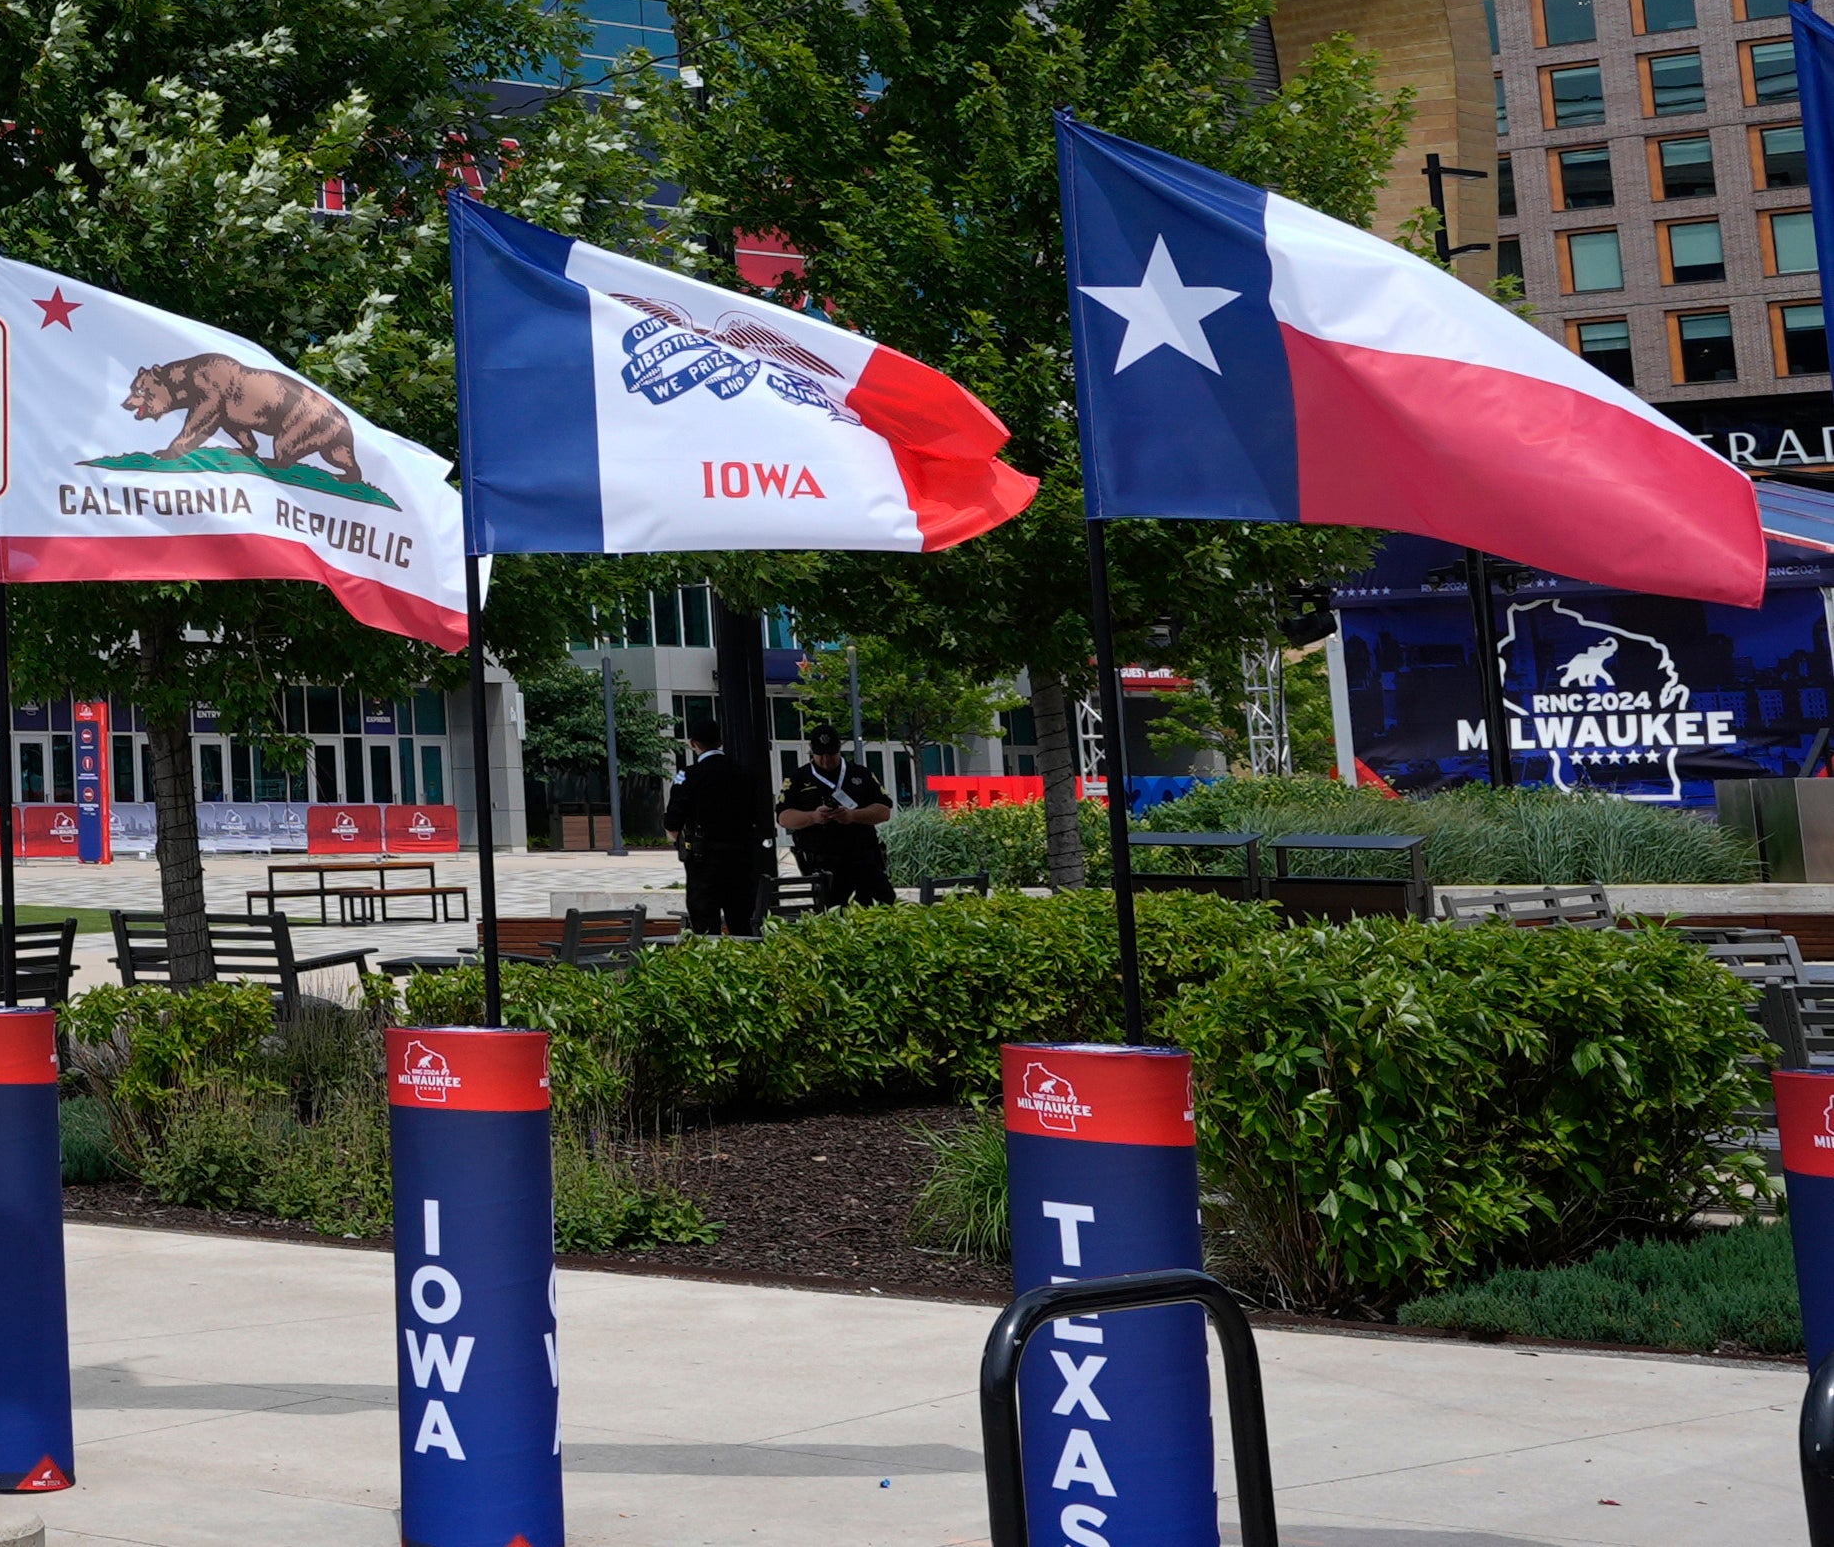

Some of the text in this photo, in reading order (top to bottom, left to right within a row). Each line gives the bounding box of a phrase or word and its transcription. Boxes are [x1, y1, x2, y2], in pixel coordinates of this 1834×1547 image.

[632, 318, 664, 341] OUR
[630, 333, 705, 378] LIBERTIES
[653, 352, 733, 400] WE PRIZE
[719, 376, 746, 397] AND
[701, 461, 827, 500] IOWA
[59, 484, 413, 568] CALIFORNIA REPUBLIC
[1533, 690, 1652, 714] RNC 2024
[1457, 710, 1738, 752] MLWAUKEE
[398, 1074, 461, 1088] MILWAUKEE
[1017, 1097, 1092, 1117] MILWAUKEE
[404, 1199, 475, 1462] IOWA
